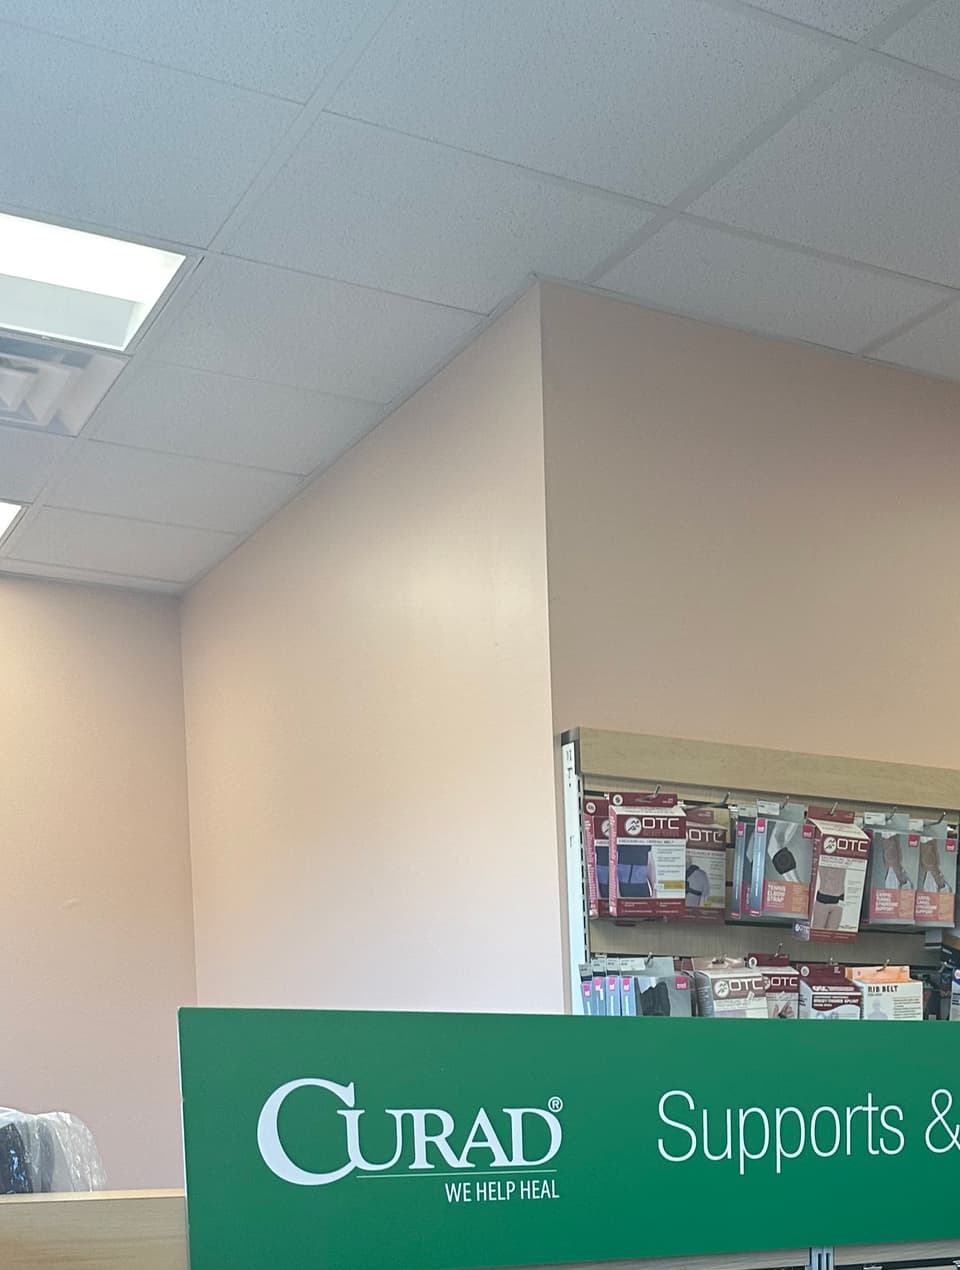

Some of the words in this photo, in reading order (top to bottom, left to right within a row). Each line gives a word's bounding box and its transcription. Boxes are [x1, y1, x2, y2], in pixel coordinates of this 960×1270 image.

[642, 817, 679, 830] OTC
[837, 838, 868, 852] OTC
[730, 977, 763, 991] OTC
[771, 976, 797, 987] OTC
[656, 1089, 905, 1176] Supports
[445, 1183, 472, 1203] WE
[476, 1181, 515, 1201] HELP
[520, 1180, 560, 1199] HEAL
